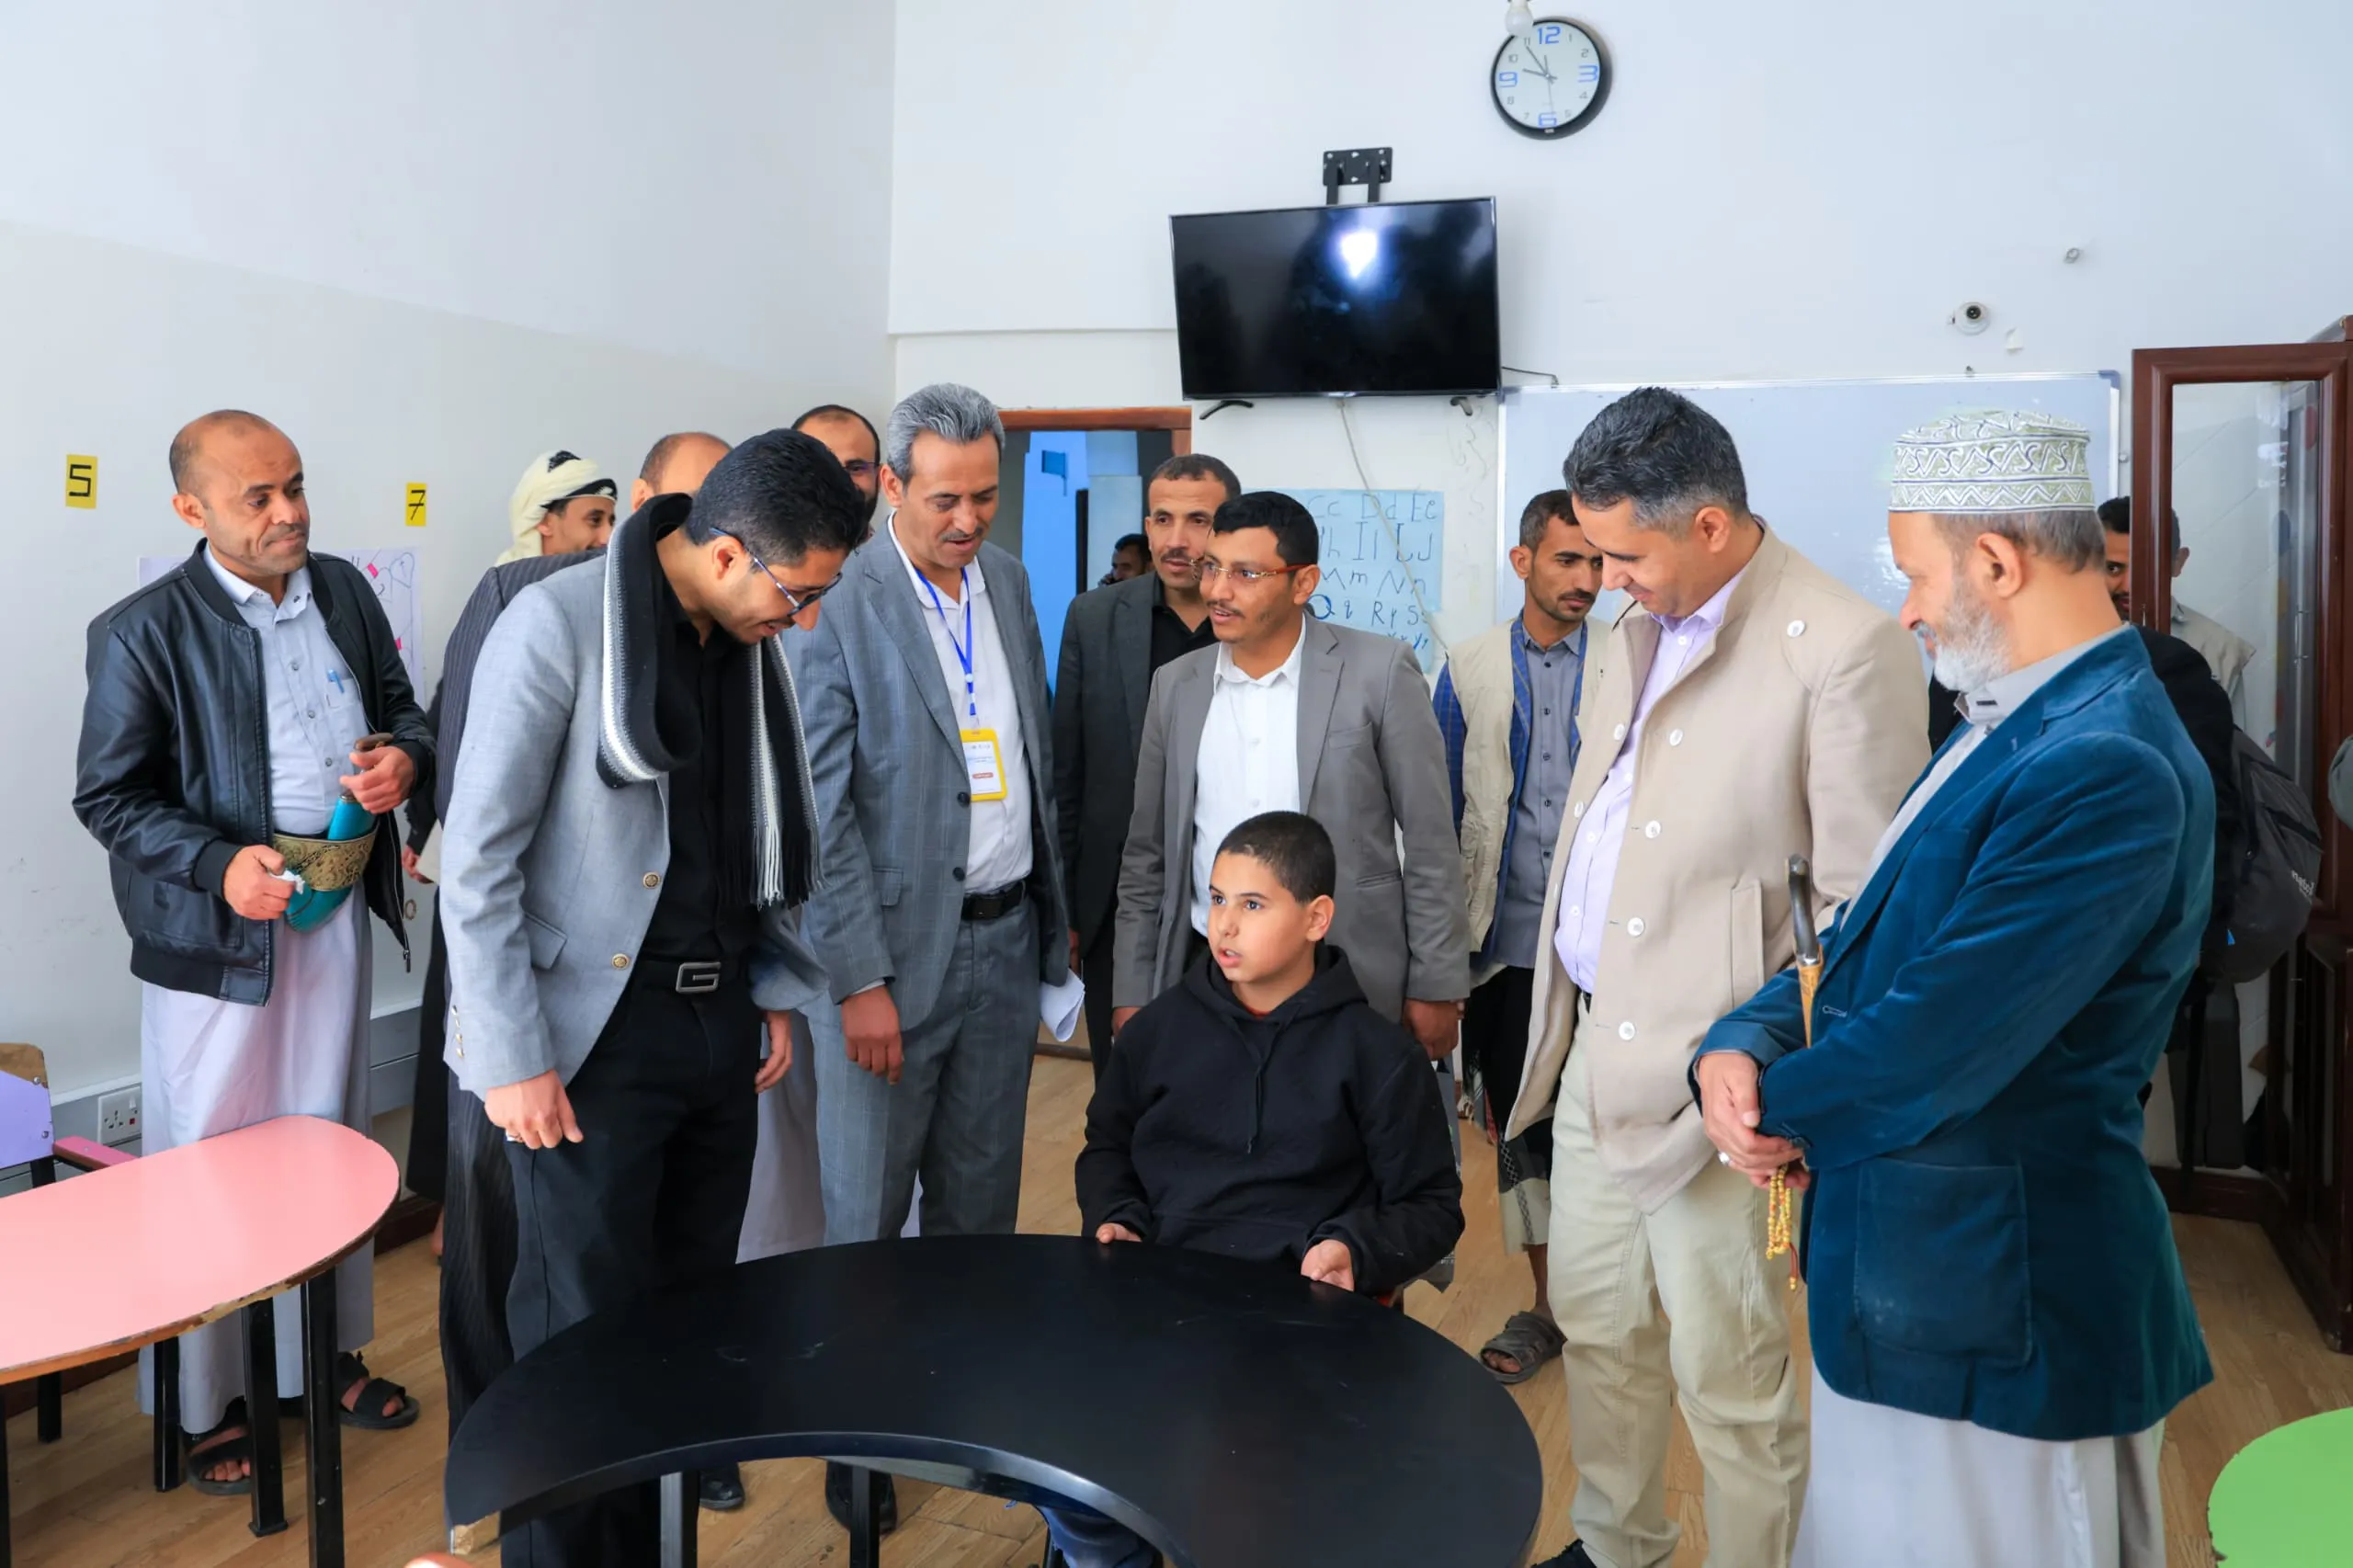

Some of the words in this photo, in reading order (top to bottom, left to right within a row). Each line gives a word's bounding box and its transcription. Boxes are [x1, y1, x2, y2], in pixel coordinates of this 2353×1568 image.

[1537, 26, 1561, 45] 12
[1581, 49, 1589, 58] 2
[1498, 72, 1518, 88] 9
[1578, 64, 1598, 83] 3
[1538, 111, 1557, 128] 6
[69, 463, 92, 497] 5
[408, 489, 426, 521] 7
